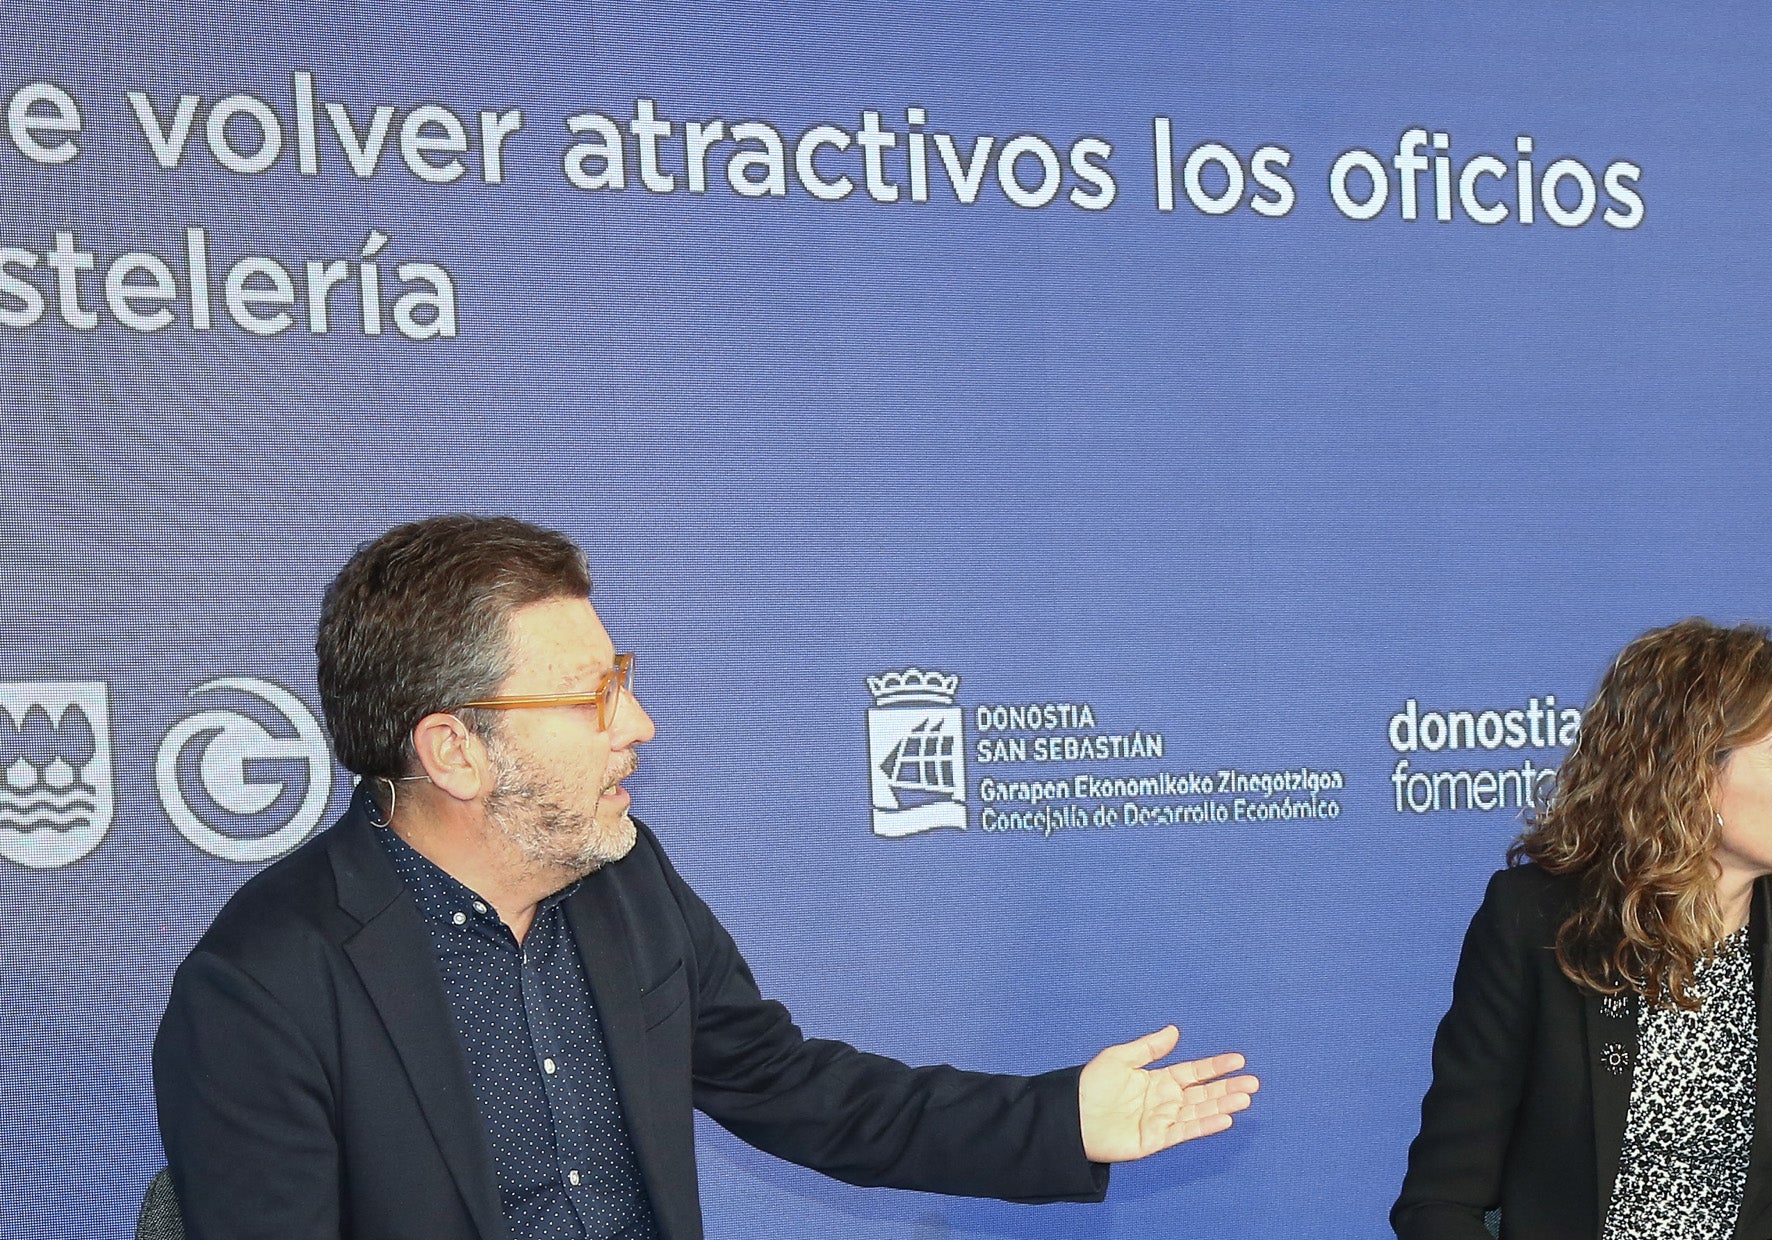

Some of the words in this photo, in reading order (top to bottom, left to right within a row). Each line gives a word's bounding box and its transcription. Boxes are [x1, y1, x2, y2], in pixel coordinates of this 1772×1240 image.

[8, 80, 82, 164] e
[128, 70, 523, 185] volver
[564, 99, 1116, 211] atractivos
[1153, 117, 1296, 217] los
[1330, 127, 1646, 230] oficios
[977, 703, 1096, 731] DONOSTIA
[1388, 695, 1583, 752] donostia
[977, 738, 1027, 763] SAN
[1034, 731, 1163, 761] SEBASTIÁN
[981, 777, 1070, 804] Garapen
[1074, 771, 1214, 799] Ekonomikoko
[1217, 767, 1344, 798] Zinegotzigoa
[1093, 804, 1118, 828] de
[1123, 800, 1230, 828] Desarrollo
[1234, 796, 1341, 824] Económico
